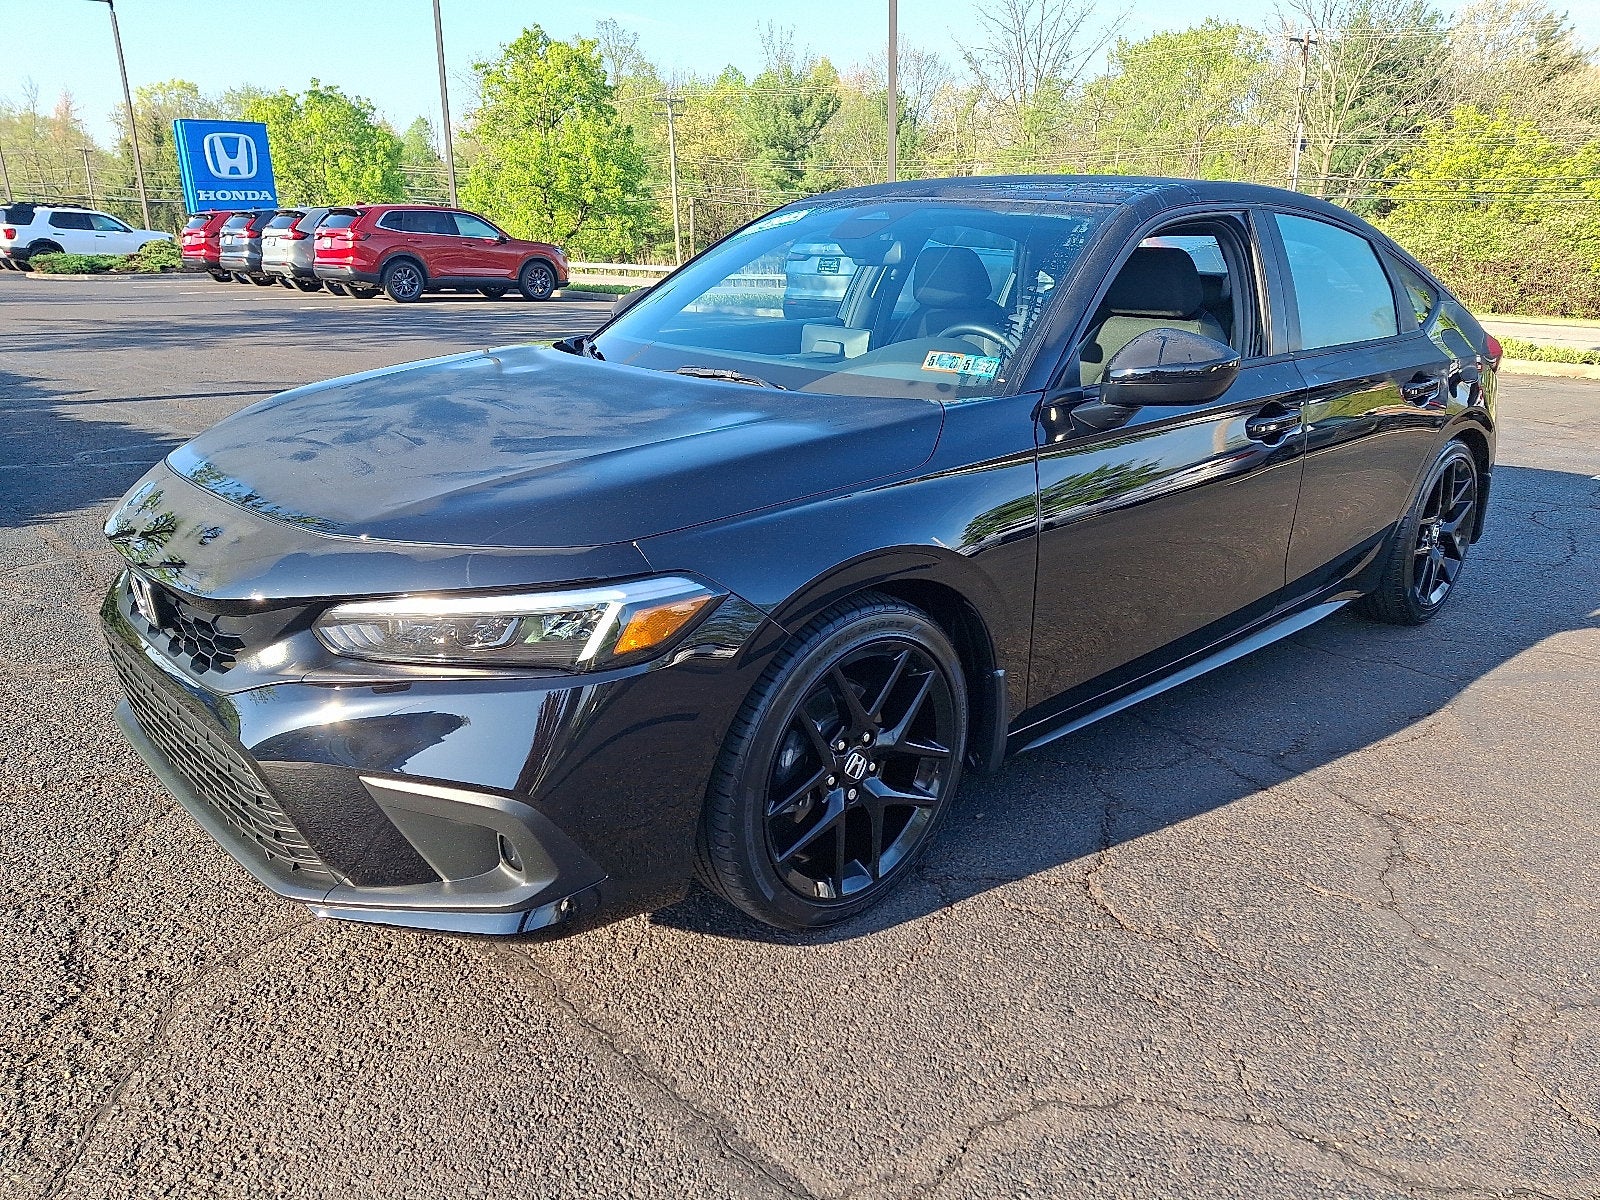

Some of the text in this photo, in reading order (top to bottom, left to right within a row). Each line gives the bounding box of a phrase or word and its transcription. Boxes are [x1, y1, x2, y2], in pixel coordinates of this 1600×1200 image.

[197, 190, 273, 200] HONDA
[928, 356, 936, 366] 5
[963, 360, 971, 370] 5
